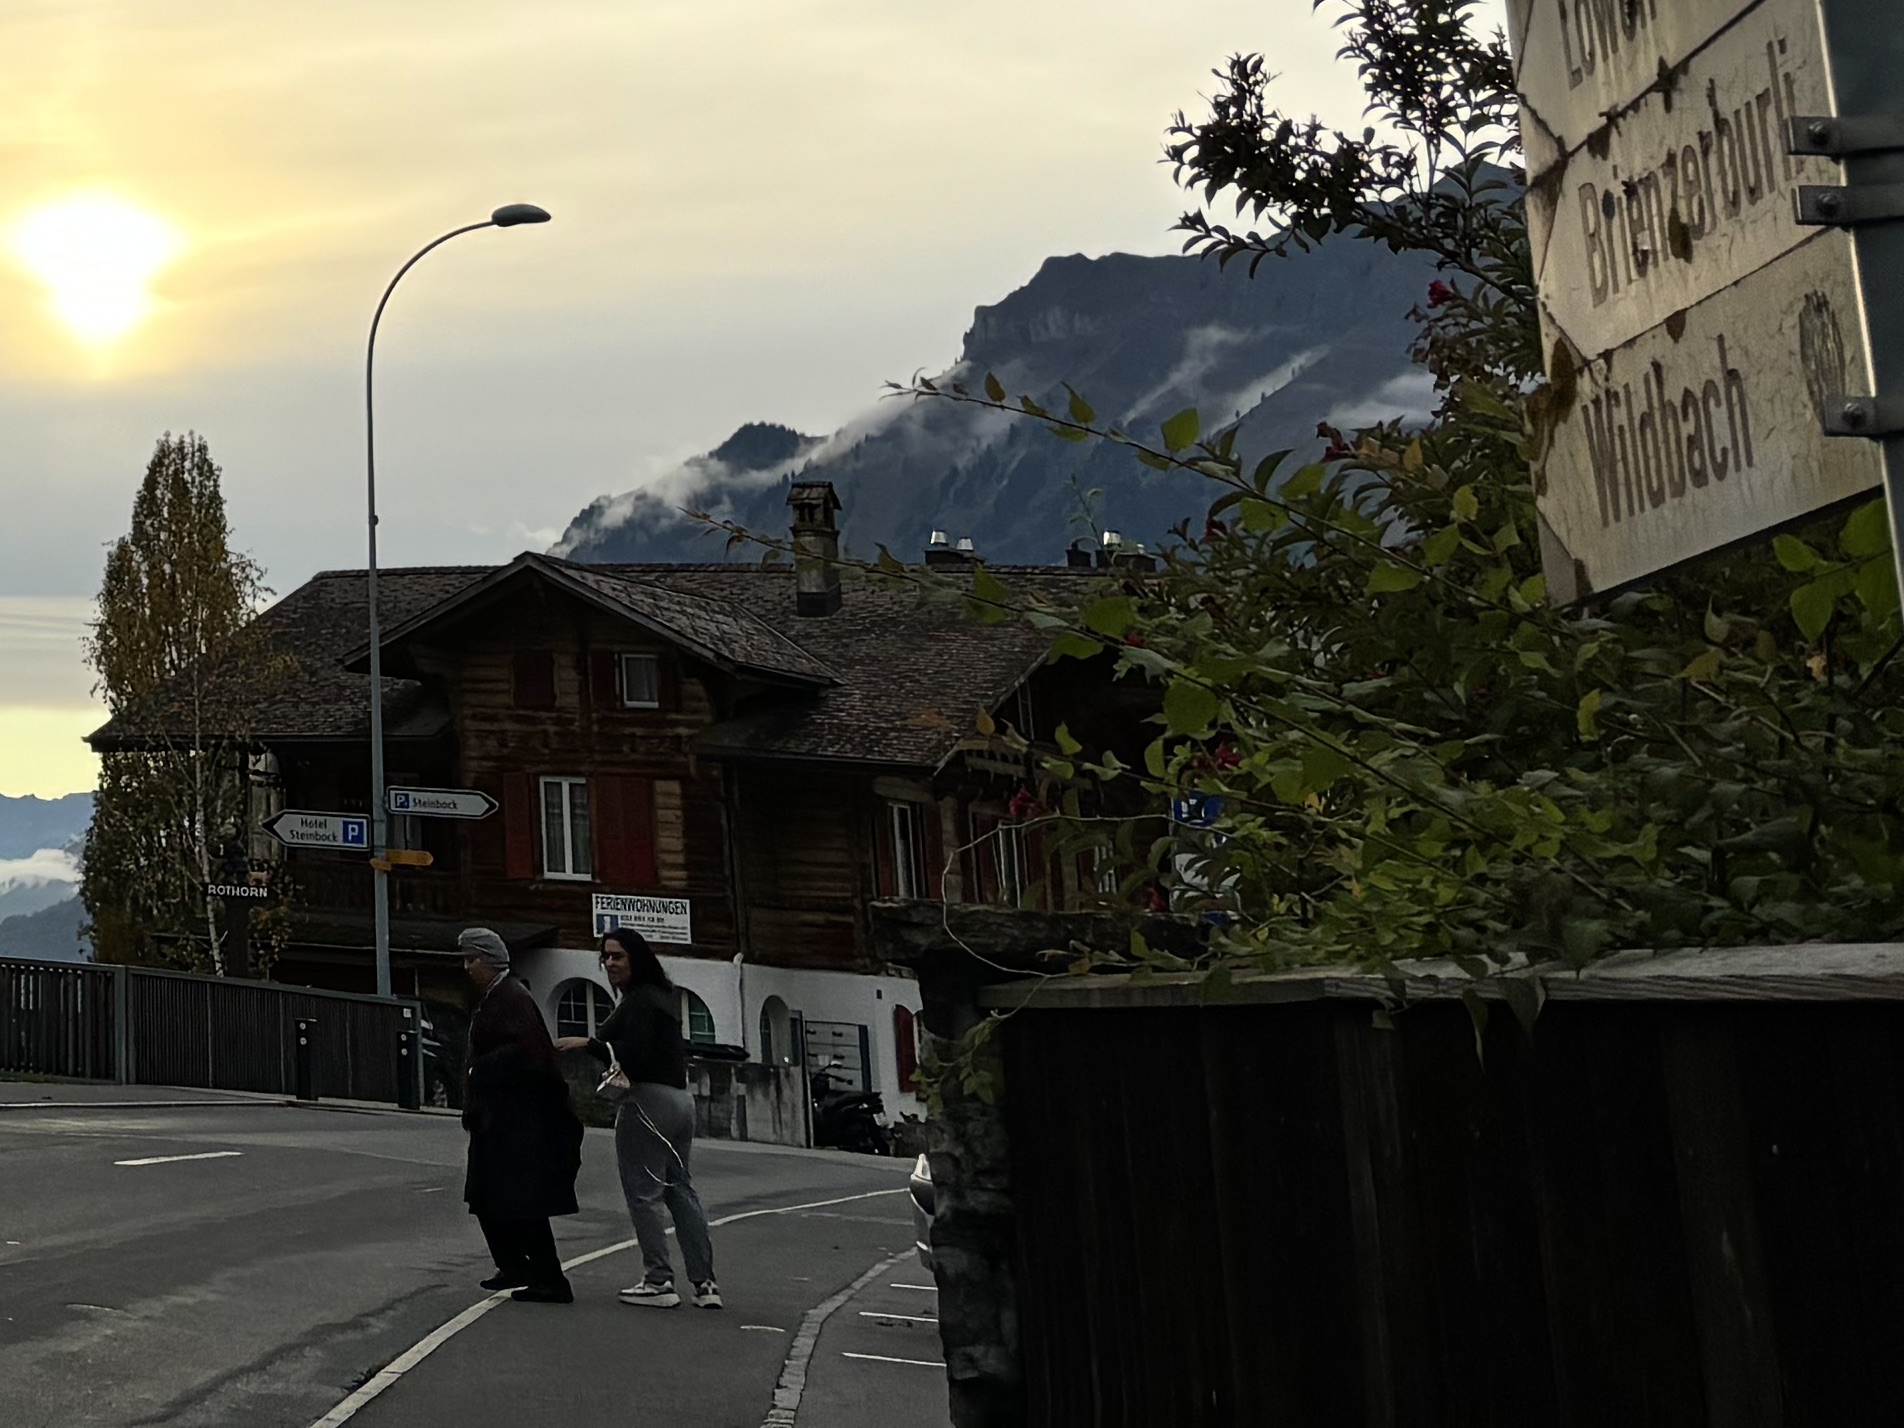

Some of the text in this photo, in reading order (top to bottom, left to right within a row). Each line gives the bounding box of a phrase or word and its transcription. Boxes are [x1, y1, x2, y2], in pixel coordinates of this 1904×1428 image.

[1582, 334, 1754, 527] Wildbach
[412, 797, 457, 810] Steinbock
[300, 817, 328, 830] Hotel
[289, 829, 339, 843] Steinbock
[347, 823, 360, 842] P
[207, 884, 268, 898] ROTHORN
[595, 895, 688, 915] FERIENWOHNUNGEN
